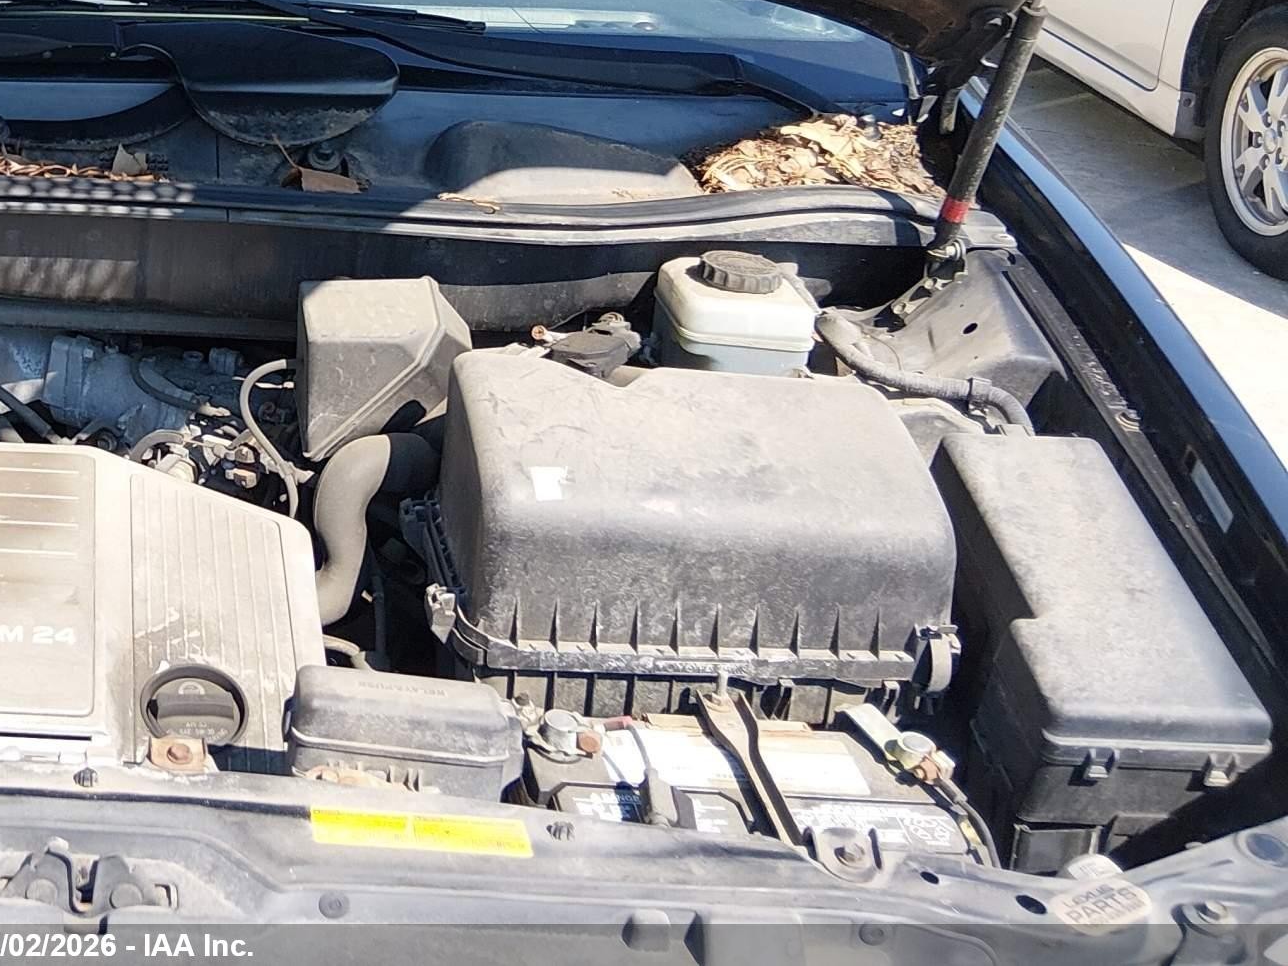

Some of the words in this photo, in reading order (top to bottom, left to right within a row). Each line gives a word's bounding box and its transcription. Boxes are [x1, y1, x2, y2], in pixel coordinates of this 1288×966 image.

[31, 625, 76, 646] 24
[1062, 884, 1114, 908] LEXUS
[1065, 887, 1137, 922] PARTS
